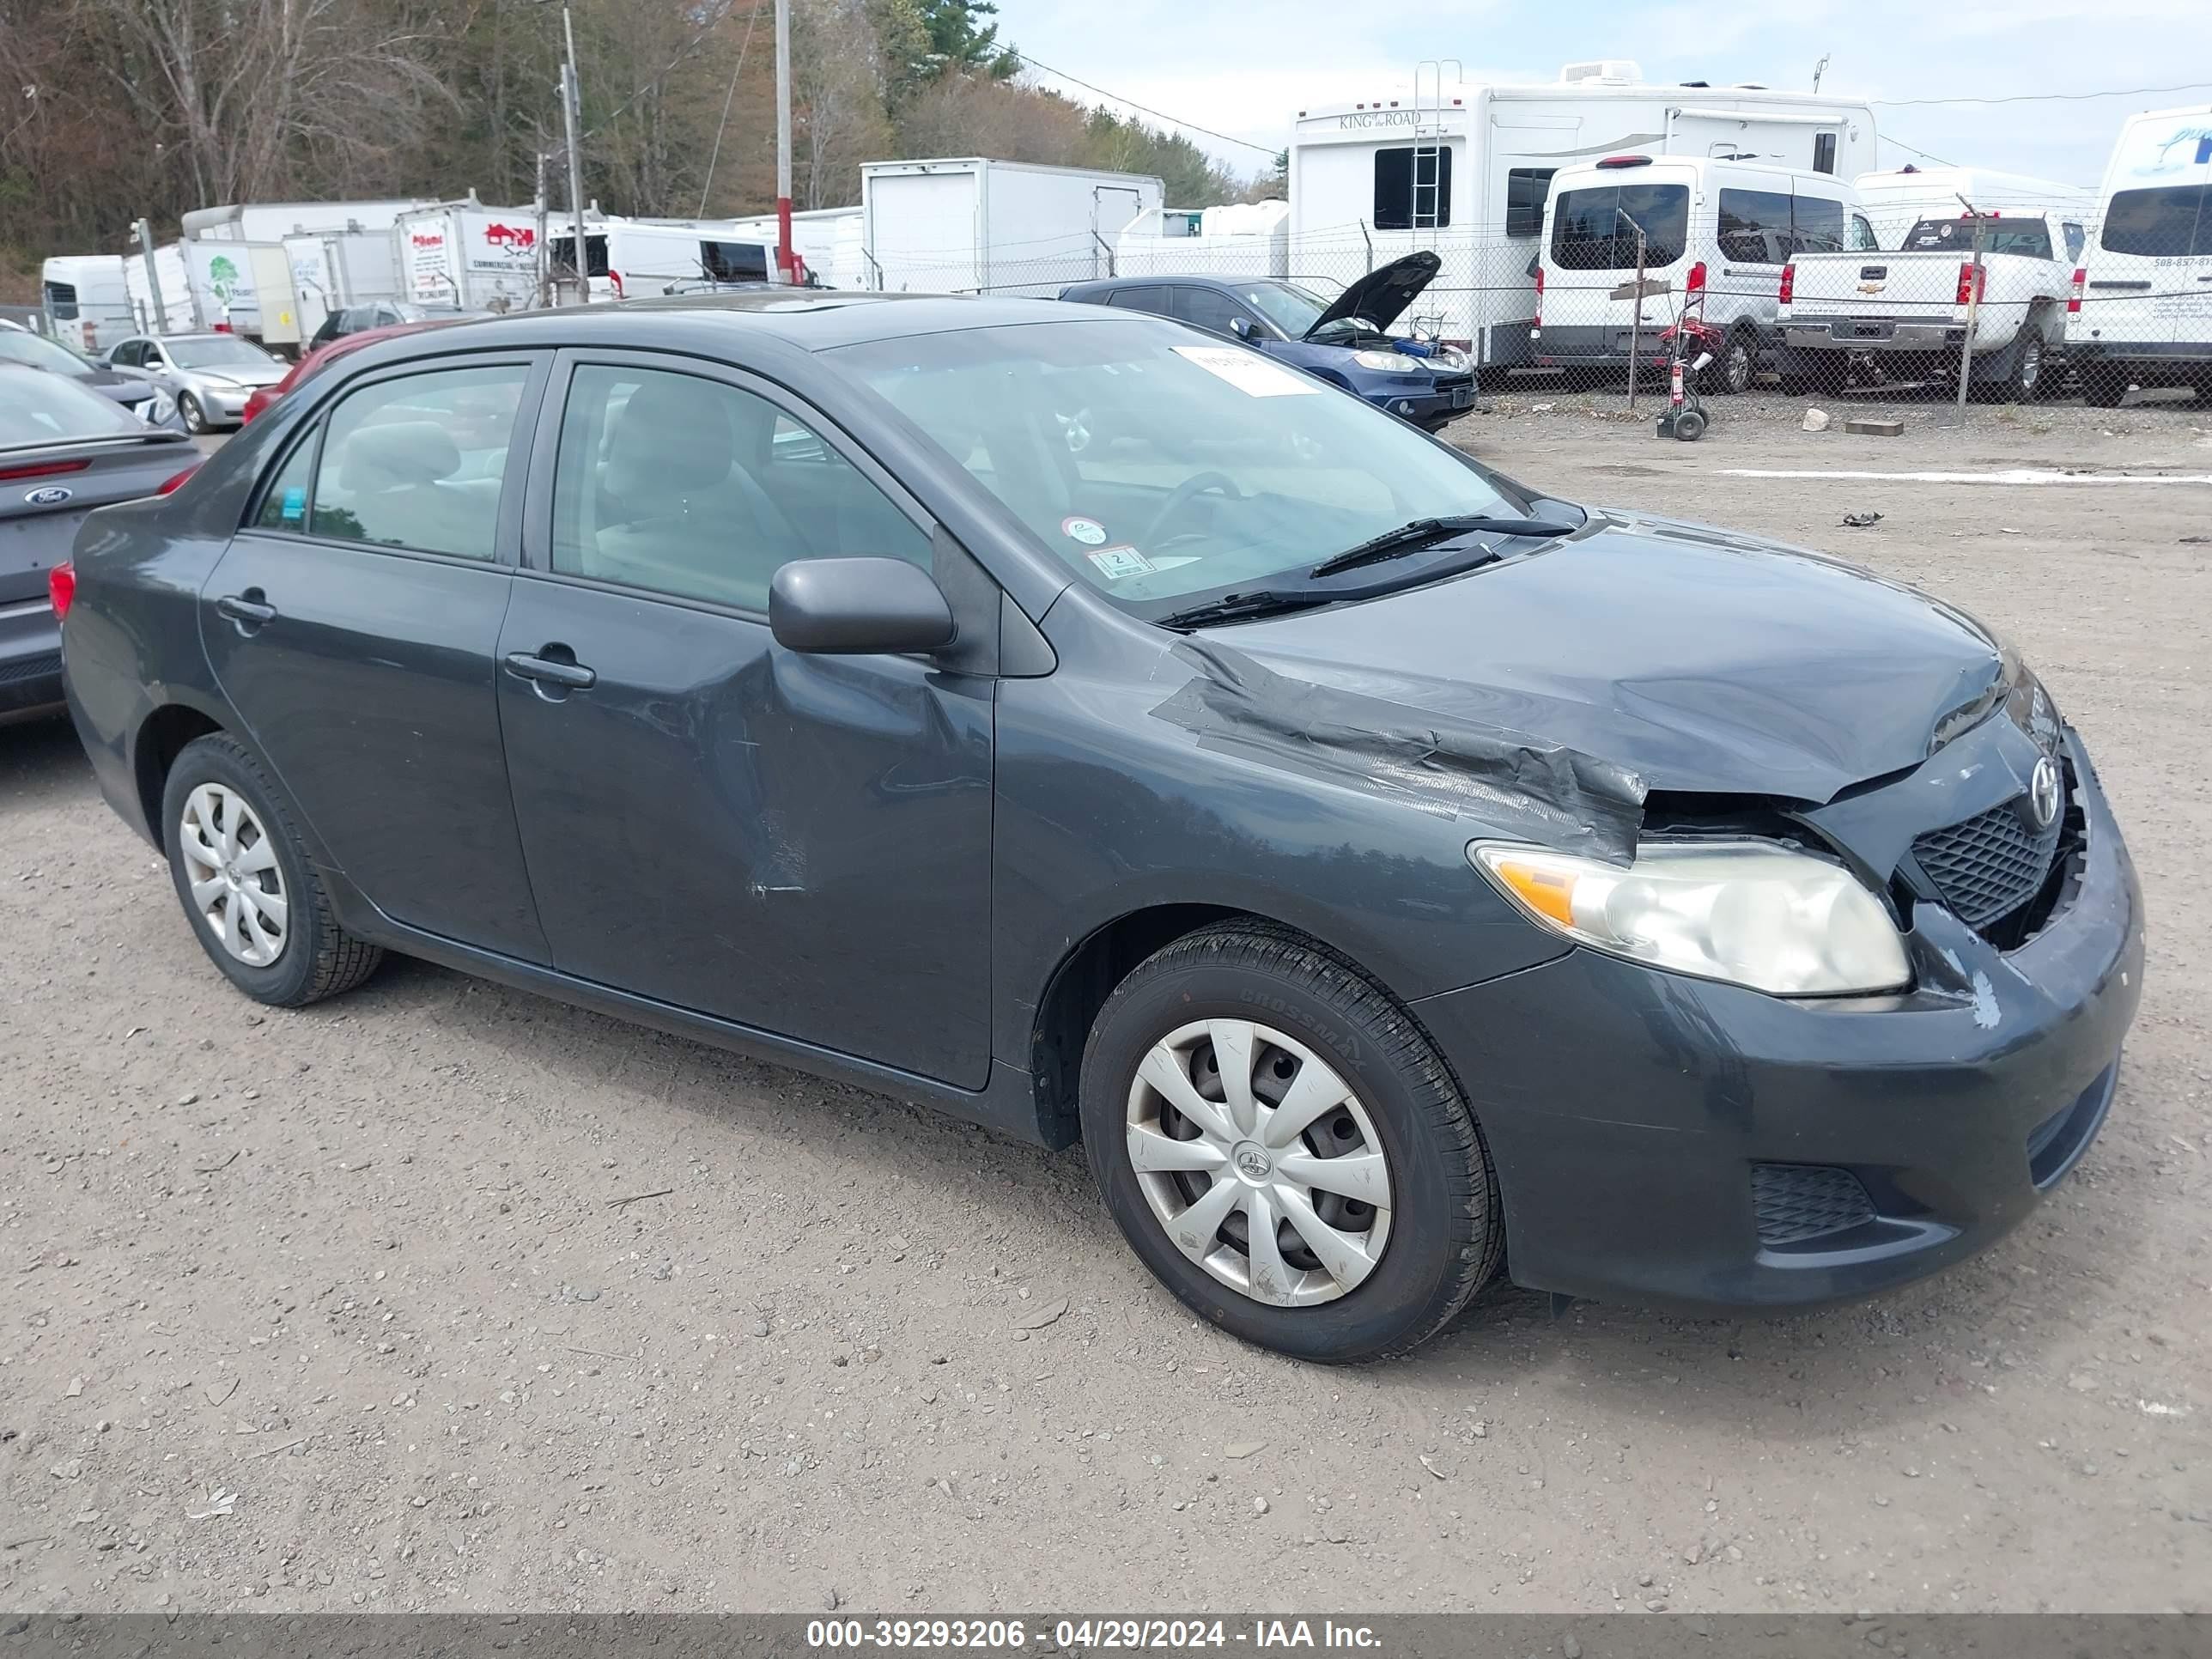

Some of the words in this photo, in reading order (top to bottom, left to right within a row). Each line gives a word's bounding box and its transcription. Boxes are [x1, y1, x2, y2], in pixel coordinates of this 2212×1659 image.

[1340, 114, 1371, 130] KING
[1385, 112, 1421, 126] ROAD
[38, 489, 63, 502] Ford
[1111, 555, 1124, 564] 2
